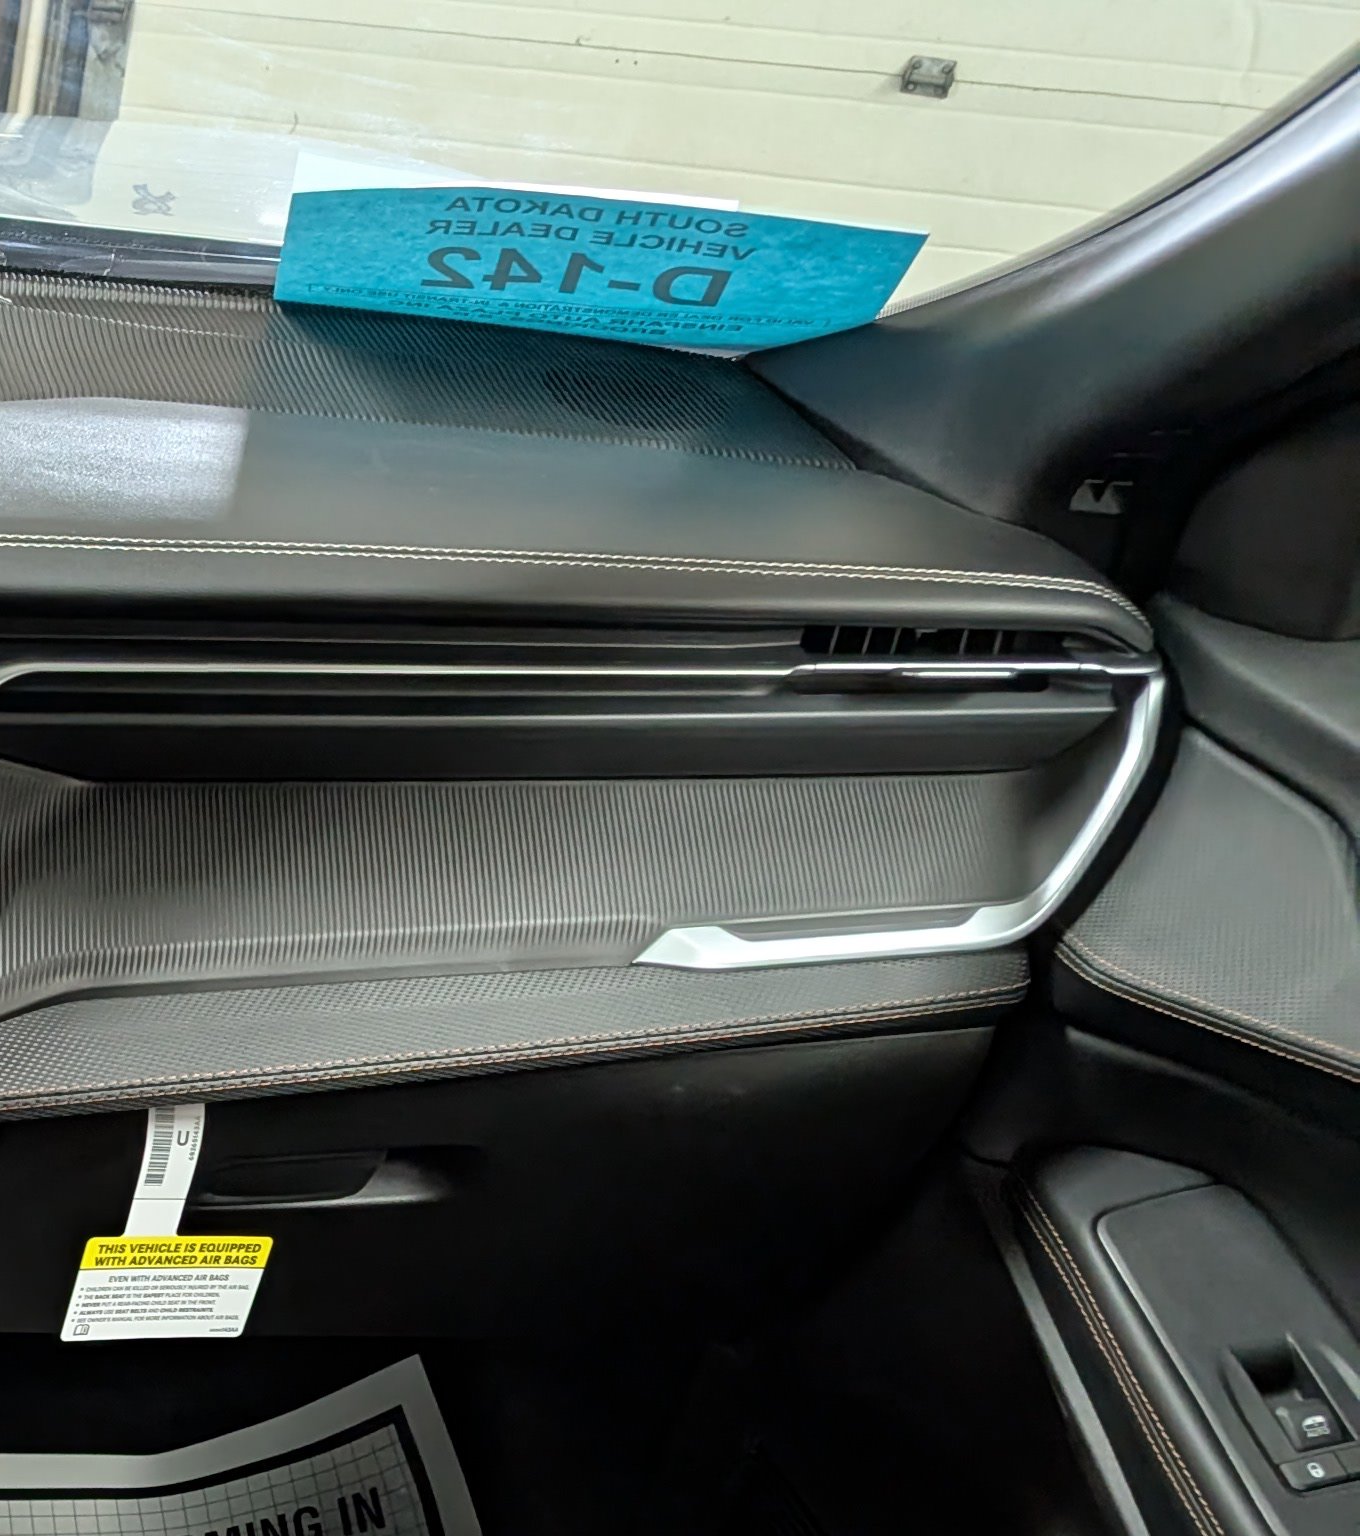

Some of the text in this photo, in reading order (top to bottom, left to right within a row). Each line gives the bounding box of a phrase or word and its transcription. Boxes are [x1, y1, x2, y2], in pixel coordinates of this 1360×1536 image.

[98, 1243, 262, 1255] THIS VEHICLE IS EQUIPPED
[94, 1255, 258, 1266] WITH ADVANCED AIR BAGS
[108, 1275, 130, 1283] EVEN
[151, 1274, 194, 1282] ADVANCED
